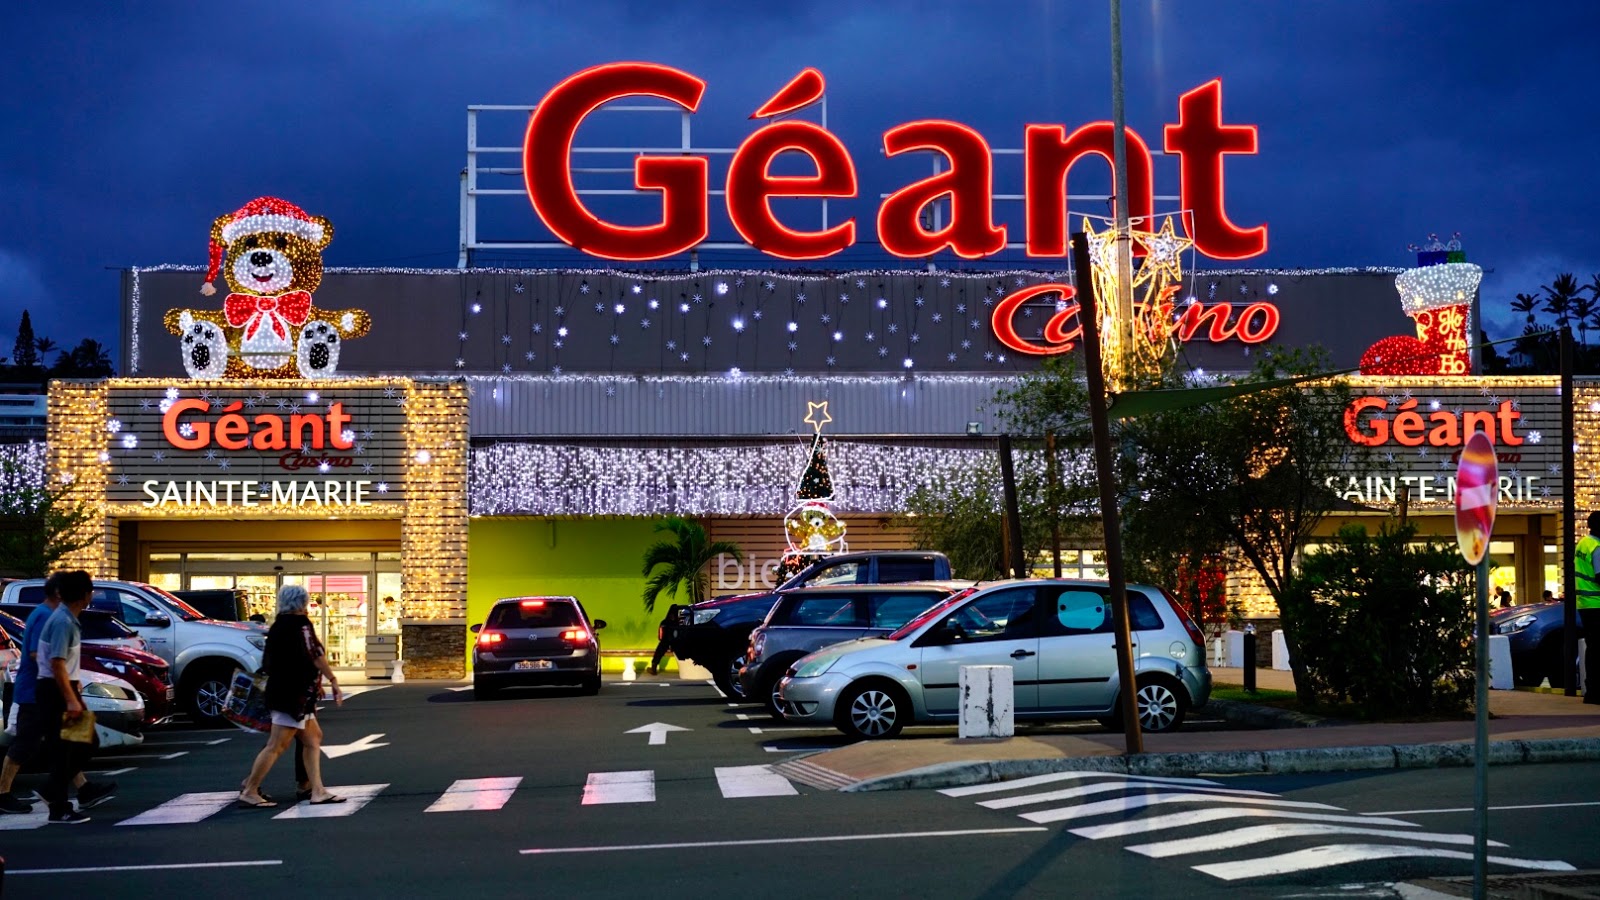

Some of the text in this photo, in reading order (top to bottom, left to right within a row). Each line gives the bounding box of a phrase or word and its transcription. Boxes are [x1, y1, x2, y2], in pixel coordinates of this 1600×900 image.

[522, 60, 1268, 261] Géant
[1439, 351, 1466, 374] Ho
[162, 398, 353, 451] Géant
[1343, 396, 1525, 447] Géant
[278, 451, 354, 471] Casino
[142, 479, 373, 508] SAINTE-MARIE
